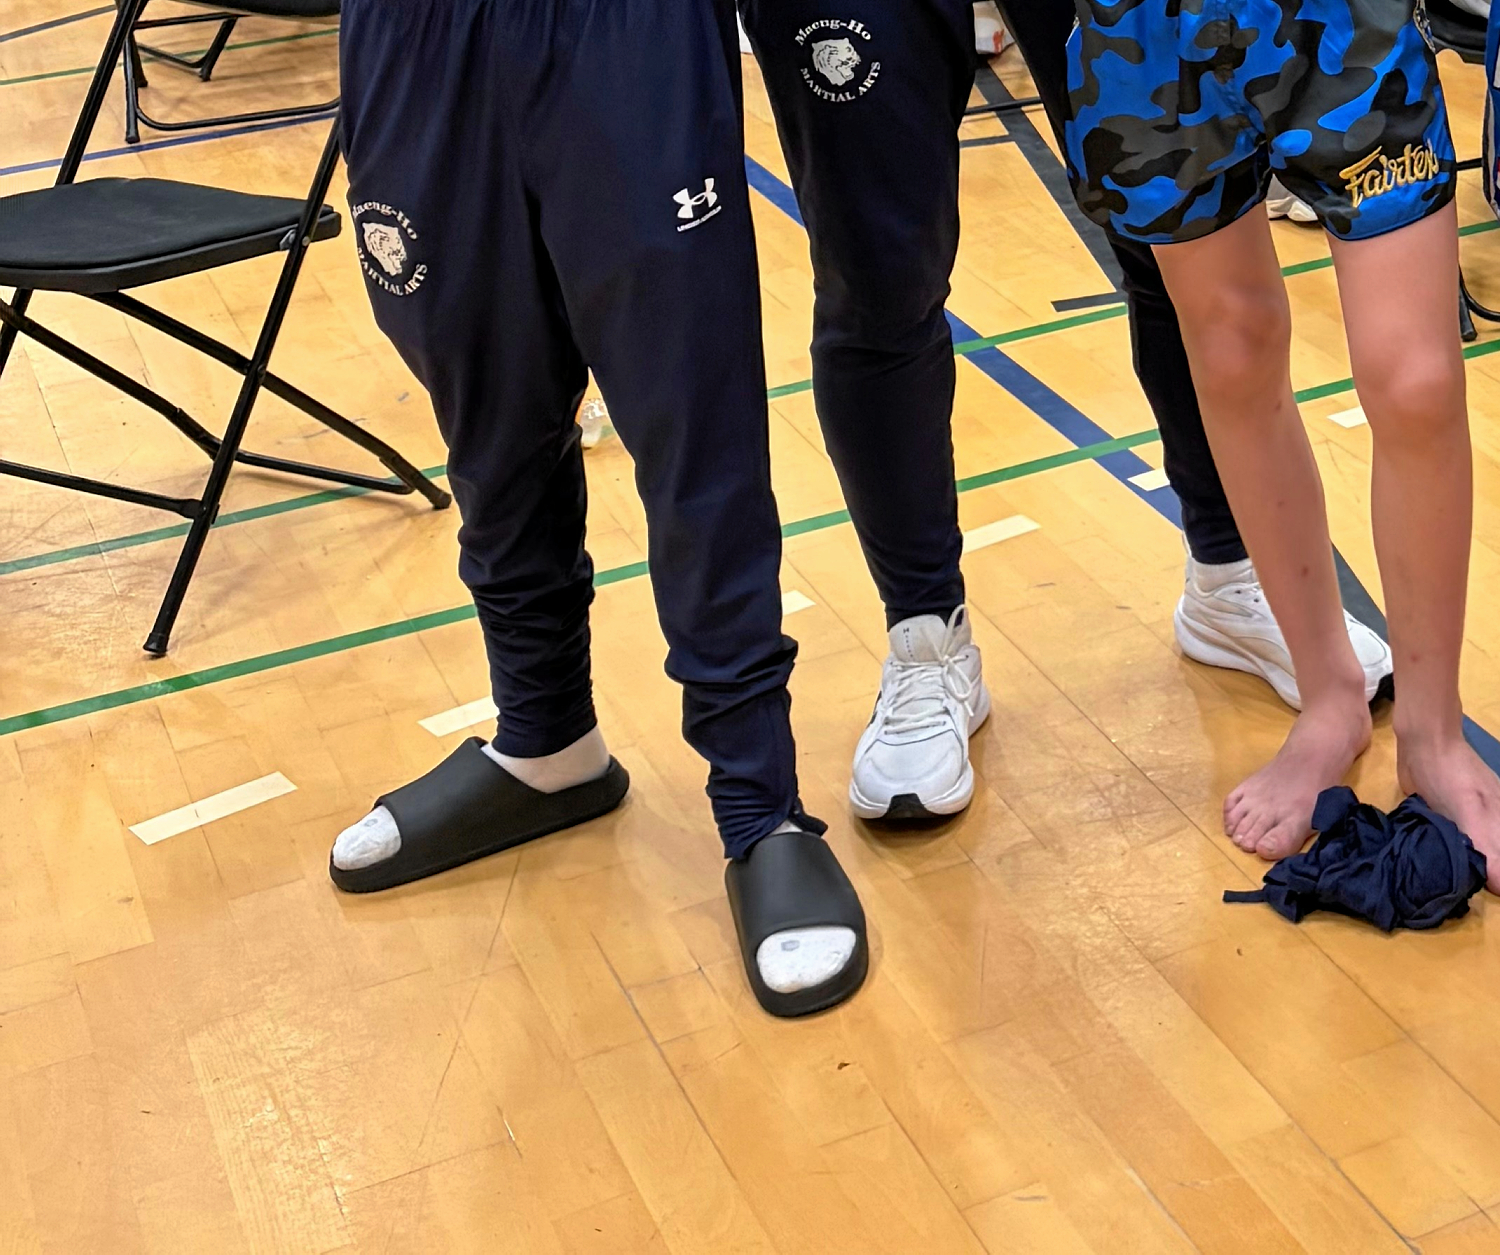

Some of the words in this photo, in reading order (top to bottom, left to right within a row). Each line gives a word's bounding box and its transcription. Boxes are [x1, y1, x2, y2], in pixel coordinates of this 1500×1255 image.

[795, 19, 871, 46] Maeng-Ho
[800, 68, 856, 102] MARTIAL
[859, 62, 881, 96] ARTS
[1339, 139, 1440, 208] Fairtex
[404, 263, 428, 295] ARTS
